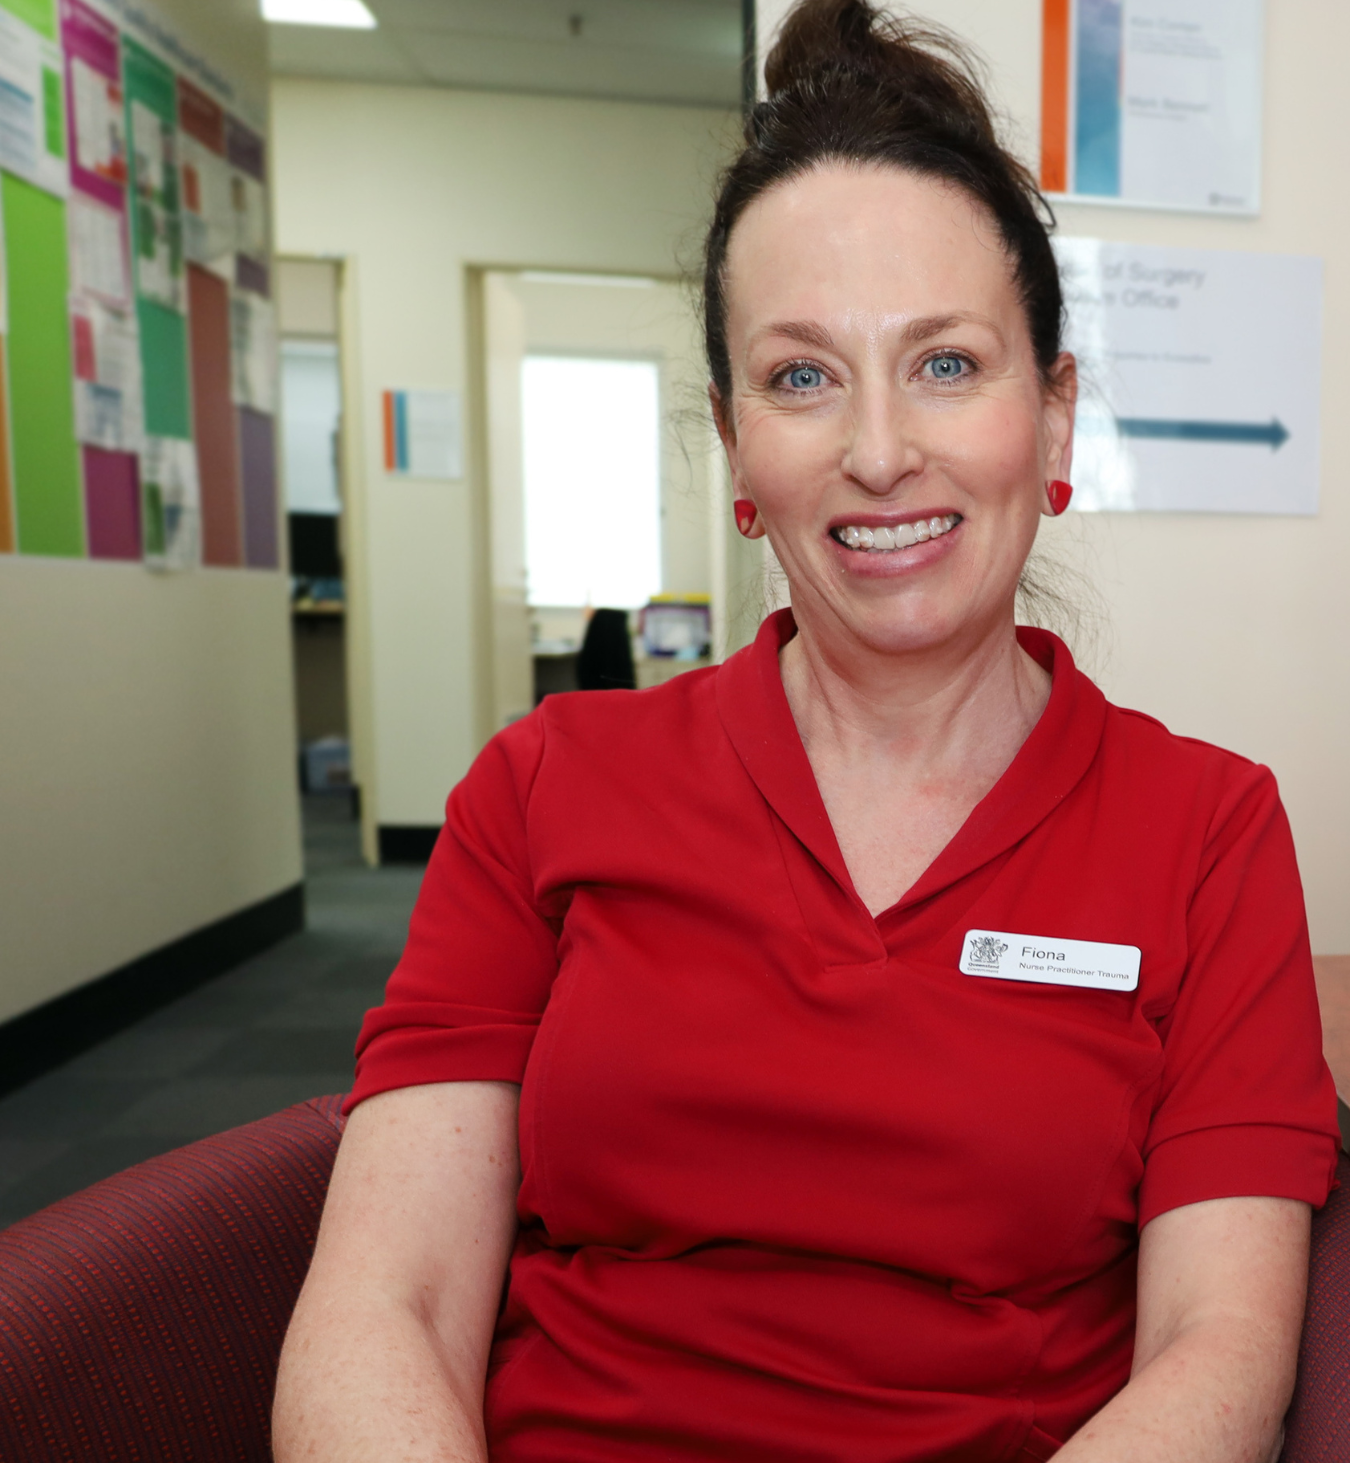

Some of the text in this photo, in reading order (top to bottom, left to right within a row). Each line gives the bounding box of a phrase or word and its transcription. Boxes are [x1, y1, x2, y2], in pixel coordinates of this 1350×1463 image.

[1129, 261, 1206, 291] Surgery
[1122, 287, 1180, 310] Office
[1021, 946, 1066, 961] Fiona
[1018, 962, 1130, 980] Nurse Practitioner Trauma
